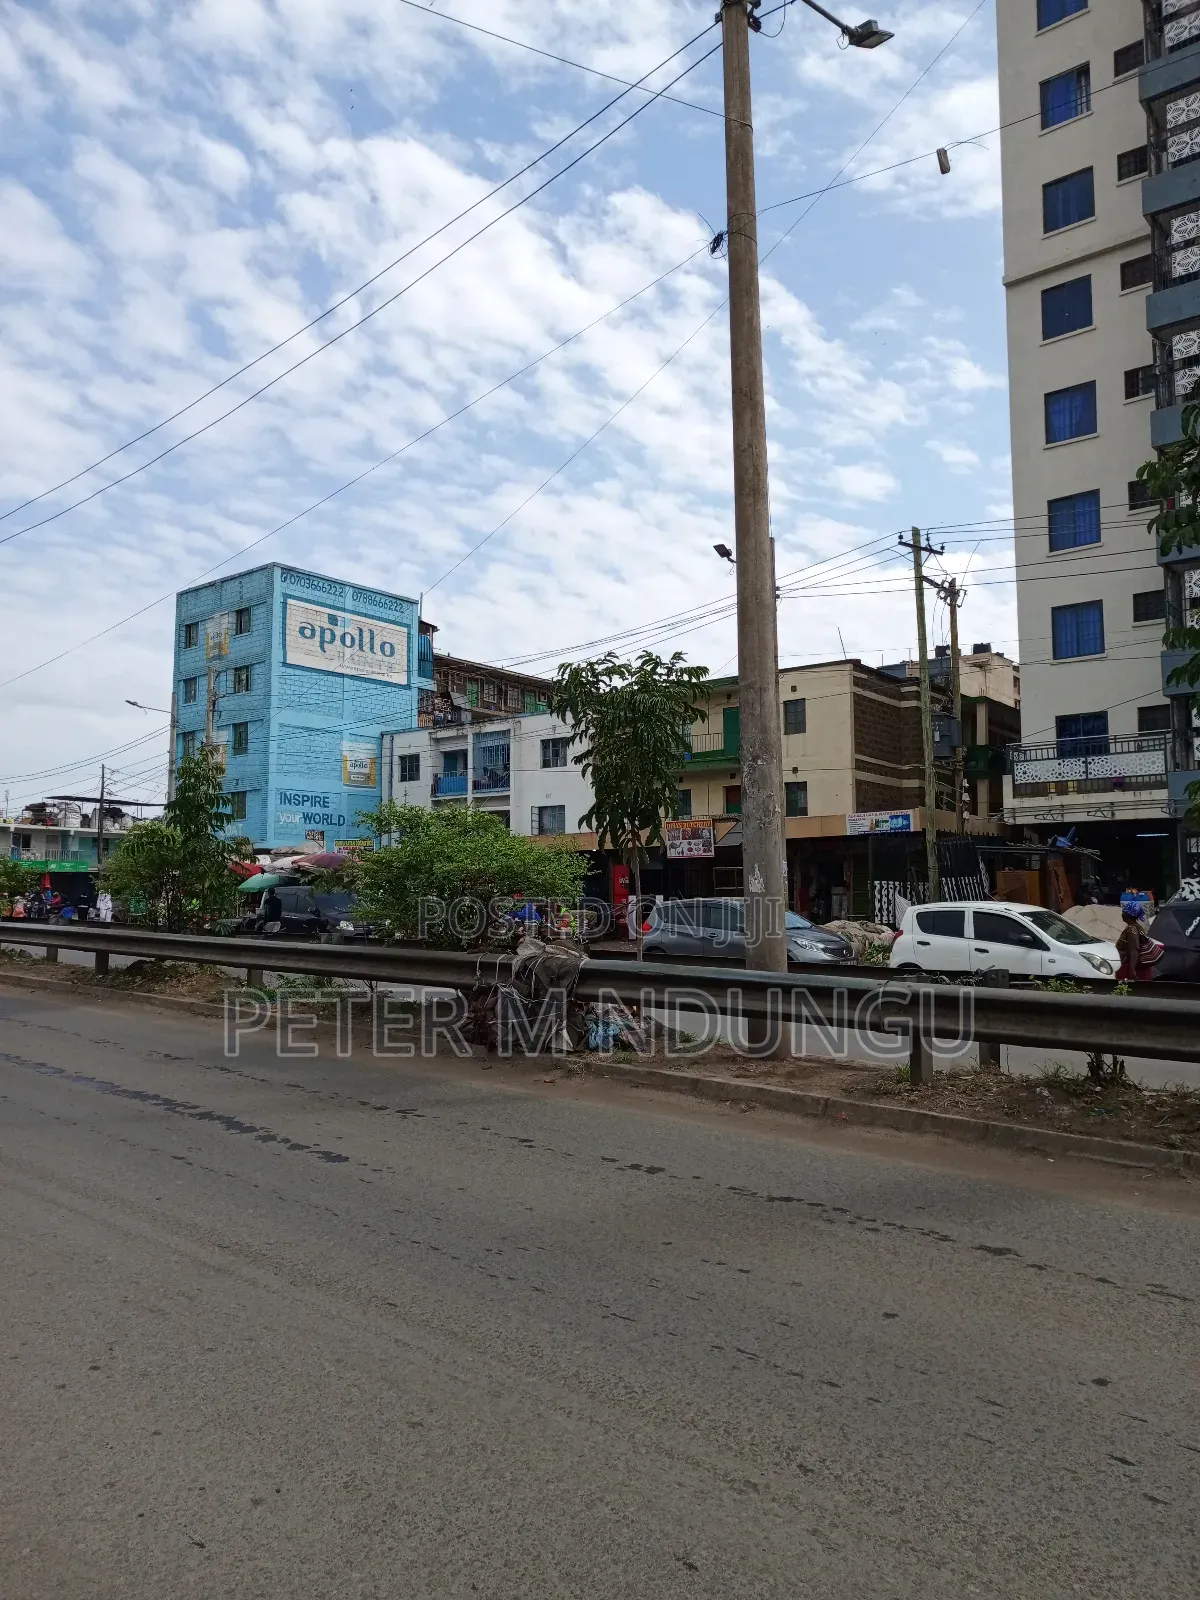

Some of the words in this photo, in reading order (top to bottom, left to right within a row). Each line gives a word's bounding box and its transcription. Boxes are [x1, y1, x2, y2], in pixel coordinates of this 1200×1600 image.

[289, 573, 344, 598] 0703666222
[351, 591, 405, 613] 0788666222
[298, 621, 395, 657] apollo
[280, 792, 329, 808] INSPIRE
[280, 813, 301, 824] your
[302, 812, 346, 826] WORLD
